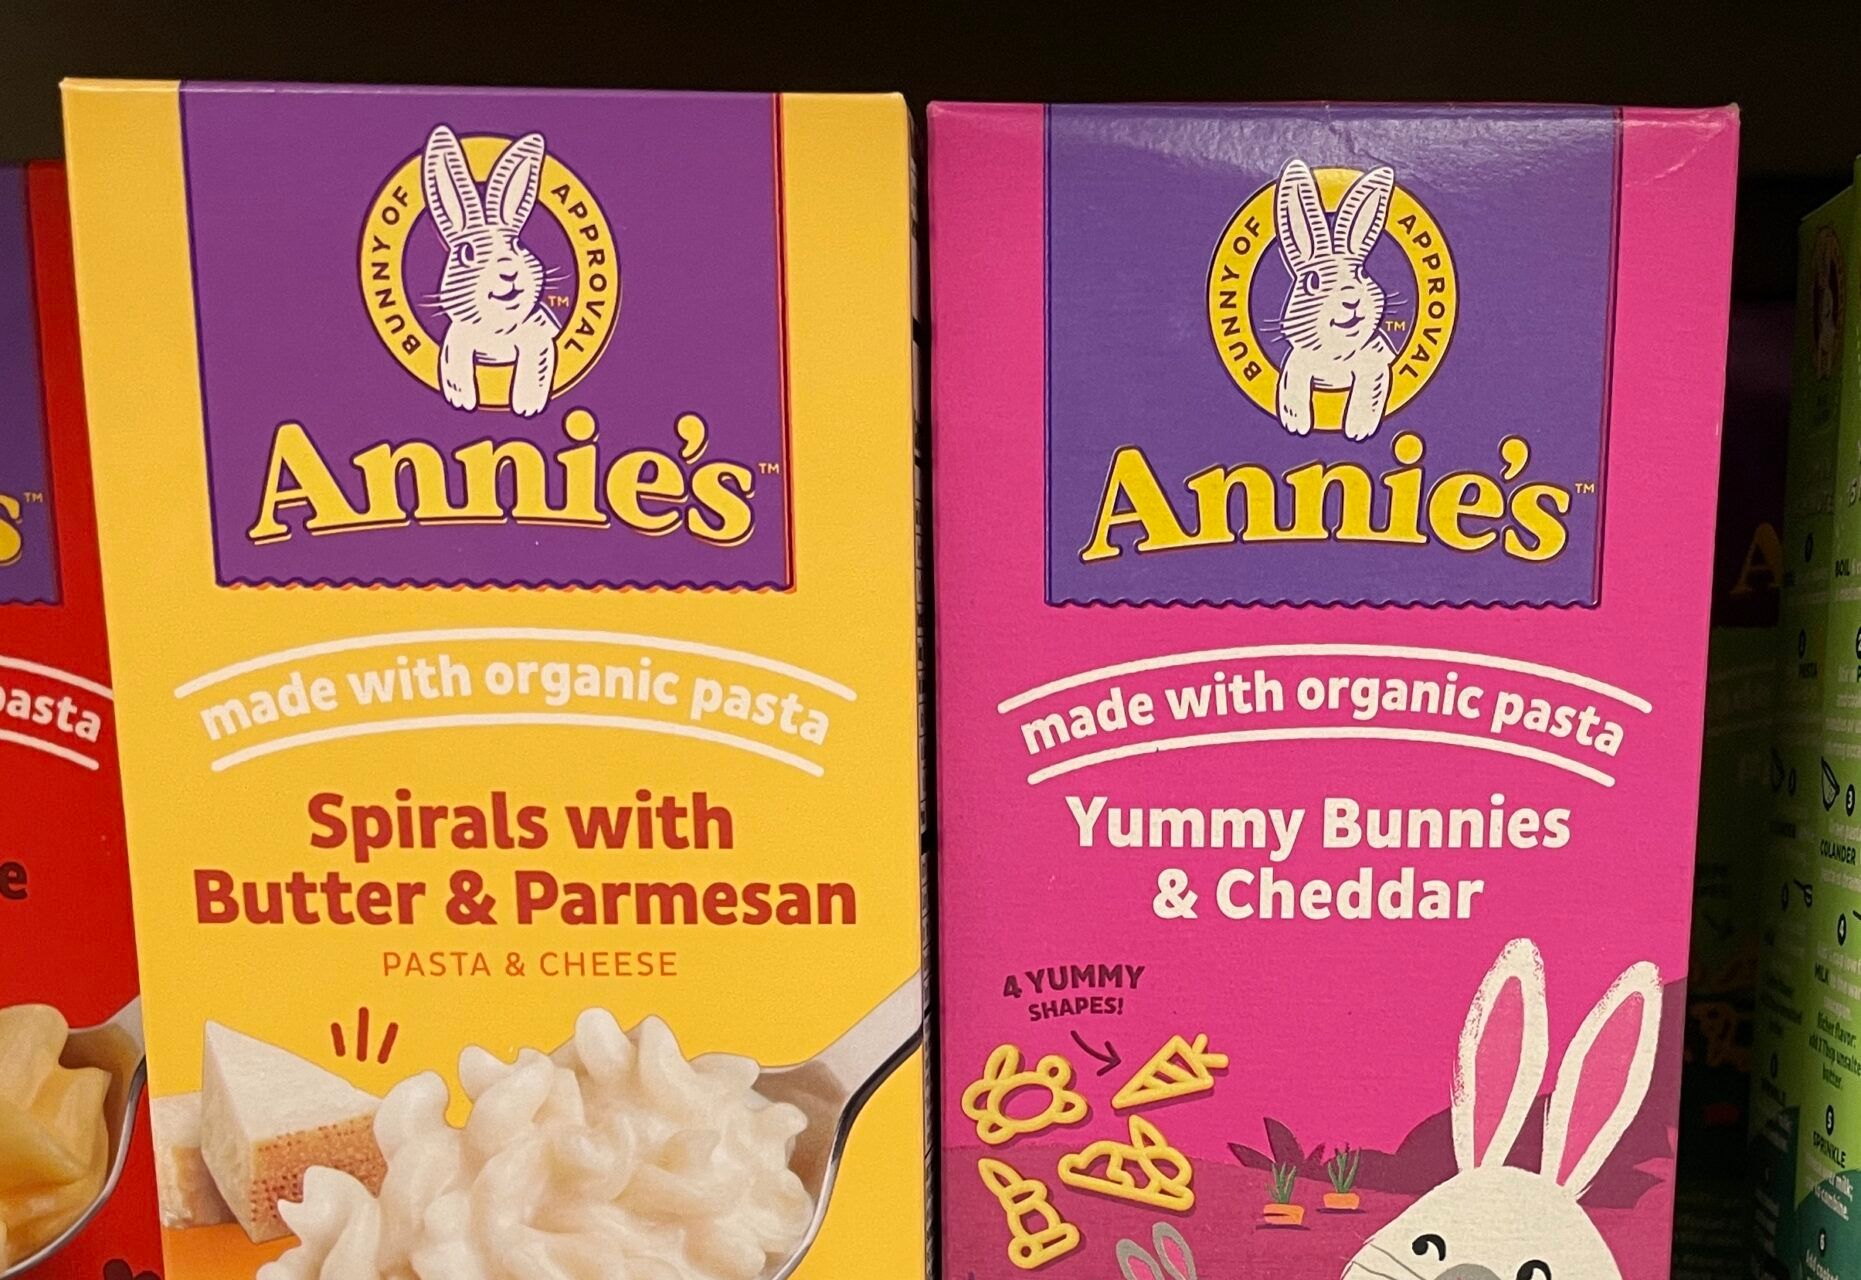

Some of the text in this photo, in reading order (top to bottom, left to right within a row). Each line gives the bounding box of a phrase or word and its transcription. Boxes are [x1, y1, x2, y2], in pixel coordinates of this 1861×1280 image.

[371, 183, 608, 356] BUNNY OF APPROVAL
[1219, 213, 1446, 383] BUNNY OF APPROVAL
[247, 409, 757, 548] Annie's
[1079, 430, 1572, 565] Annie's
[200, 656, 831, 747] made with organic pasta
[1019, 670, 1627, 757] made with organic pasta
[310, 789, 735, 864] Spirals with
[1066, 792, 1572, 864] Yummy Bunnies
[1820, 839, 1856, 866] COLANDER
[193, 868, 858, 926] Butter & Parmesan
[1152, 867, 1485, 921] & Cheddar
[382, 951, 678, 978] PASTA & CHEESE
[1003, 963, 1146, 999] 4 YUMMY
[1028, 996, 1124, 1022] SHAPES!
[1813, 1131, 1847, 1169] SPRINKLE
